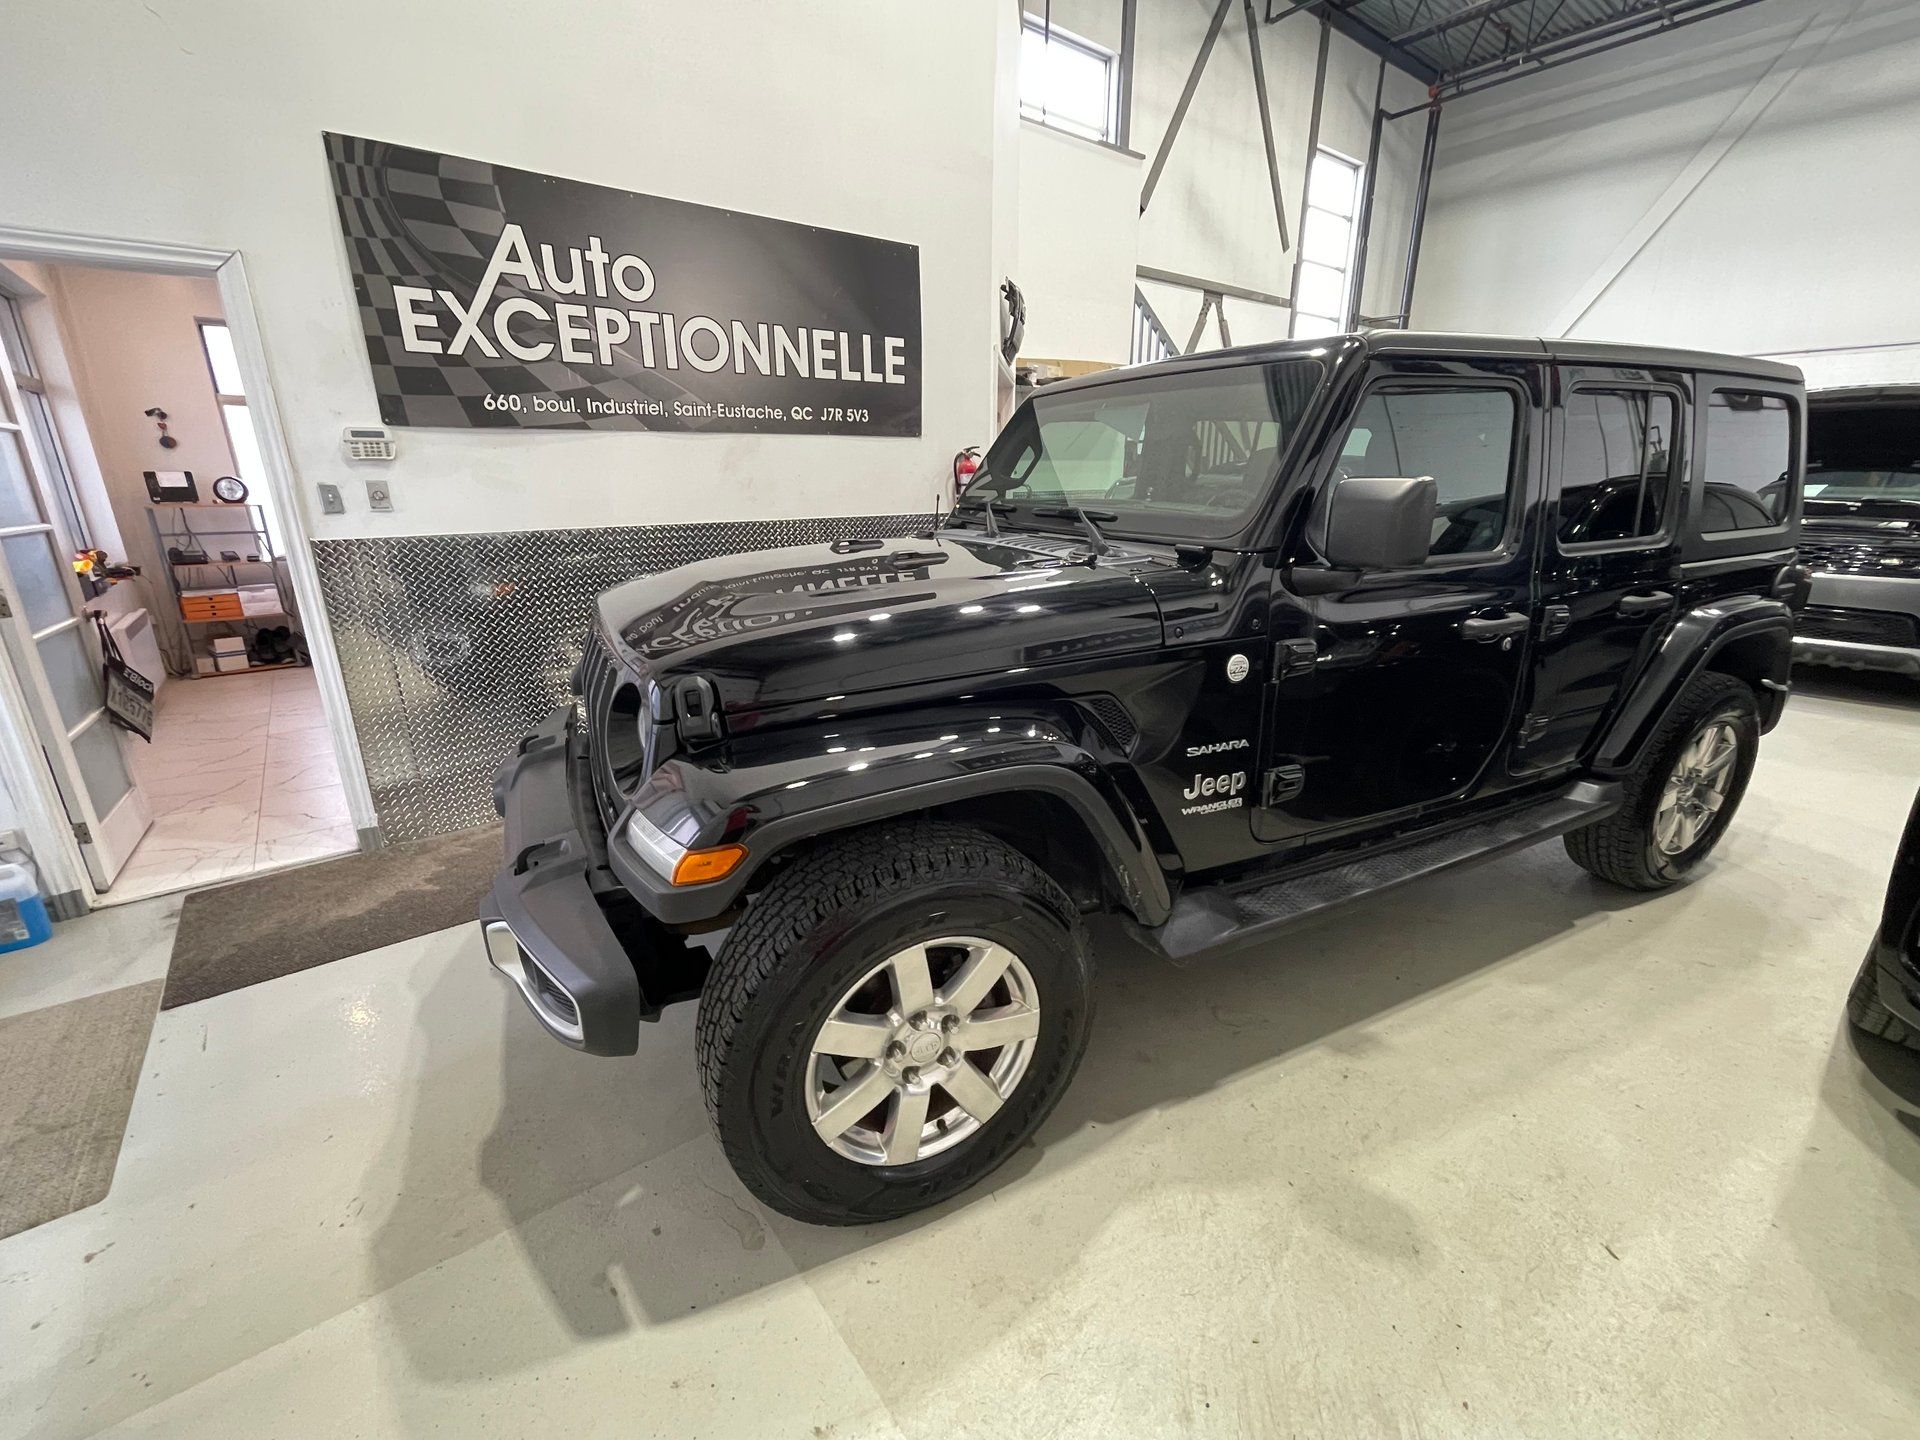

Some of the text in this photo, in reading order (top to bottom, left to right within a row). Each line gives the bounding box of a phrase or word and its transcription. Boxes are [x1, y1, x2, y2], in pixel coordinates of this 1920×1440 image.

[486, 222, 656, 303] Auto
[392, 284, 906, 385] EXCEPTIONNELLE
[483, 393, 869, 423] 660, boul. Industriel, Saint-Eustache, QC J7R 5V3
[1186, 738, 1250, 758] SAHARA
[1183, 770, 1247, 800] Jeep
